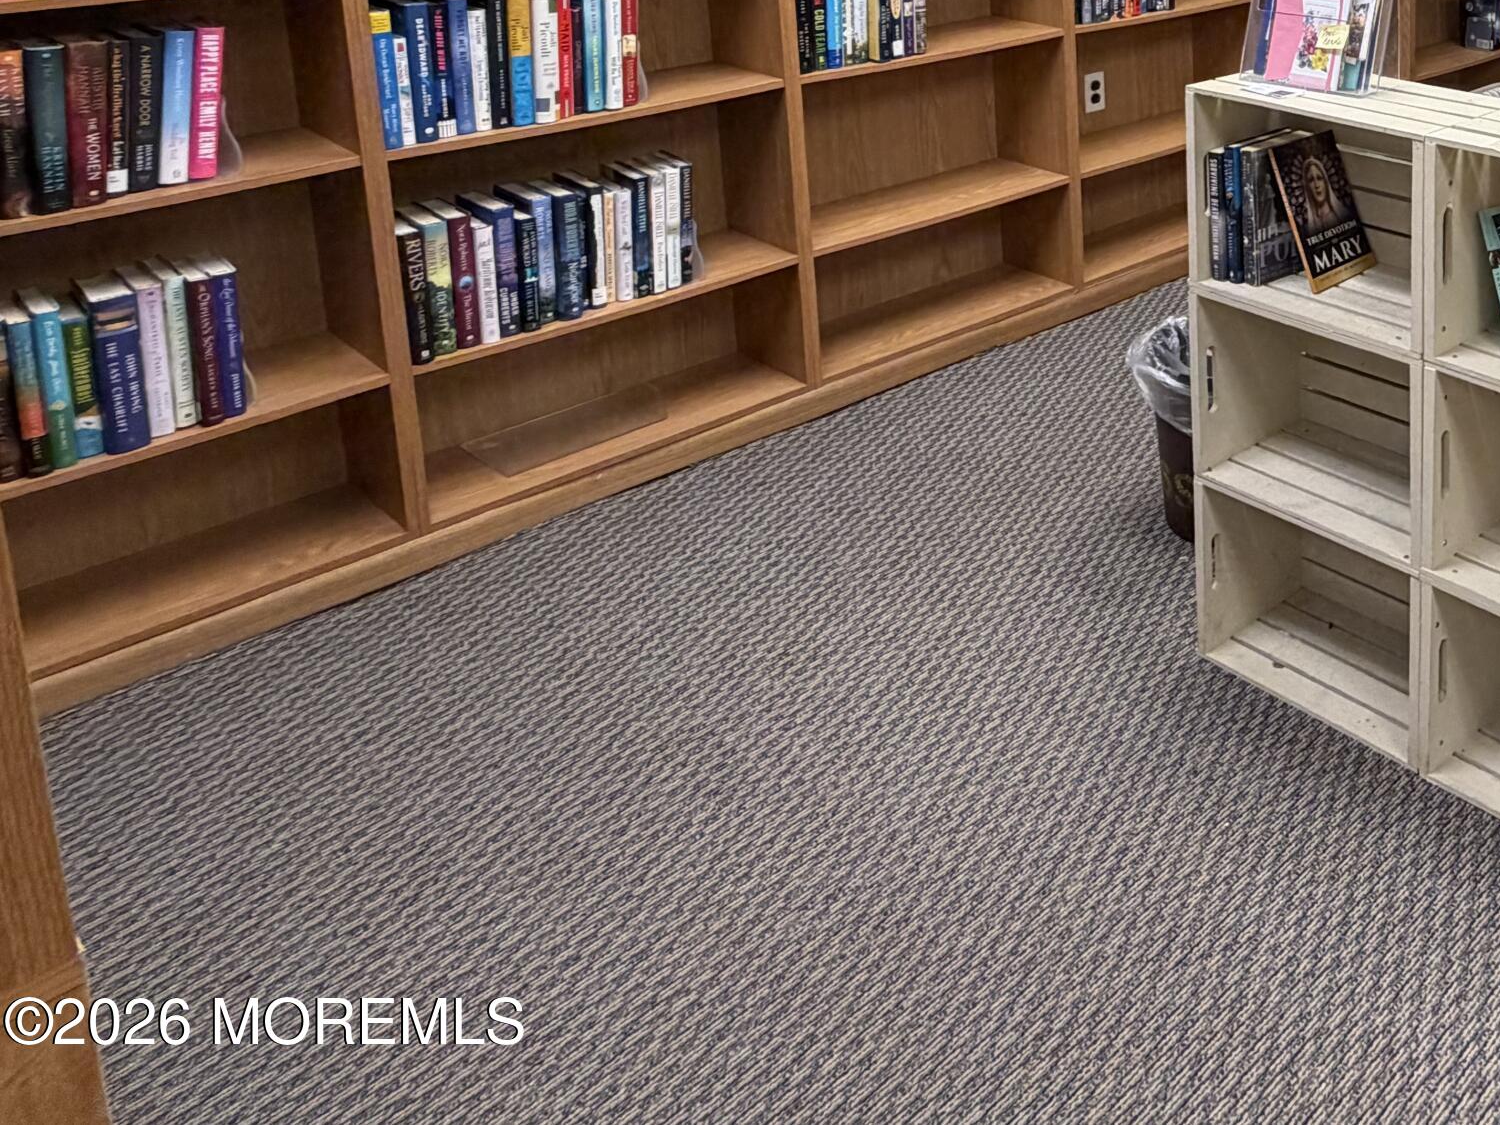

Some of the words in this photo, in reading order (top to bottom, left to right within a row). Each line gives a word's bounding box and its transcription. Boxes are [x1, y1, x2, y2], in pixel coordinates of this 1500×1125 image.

[415, 18, 427, 42] DEAR
[200, 34, 219, 62] HAPPY
[417, 43, 429, 78] EDWARD
[139, 55, 151, 96] NARROW
[199, 66, 218, 93] PLACE
[138, 99, 151, 127] DOOR
[198, 100, 218, 127] EMILY
[86, 132, 101, 181] WOMEN
[198, 131, 217, 160] HENRY
[1209, 158, 1219, 196] SURVIVING
[637, 181, 647, 212] DANIELLE
[1210, 198, 1219, 220] DEATH
[564, 201, 578, 223] NORA
[639, 214, 648, 233] STEEL
[1306, 231, 1323, 247] TRUE
[1323, 219, 1358, 240] DEVOTION
[405, 238, 425, 292] RIVERS
[1313, 235, 1363, 274] MARY
[435, 290, 450, 335] IDENTITY
[500, 287, 511, 324] CURRENTS
[105, 342, 118, 358] THE
[108, 362, 121, 384] LAST
[125, 353, 138, 379] JOHN
[110, 386, 128, 433] CHAIRLIFT
[128, 381, 142, 414] IRVING
